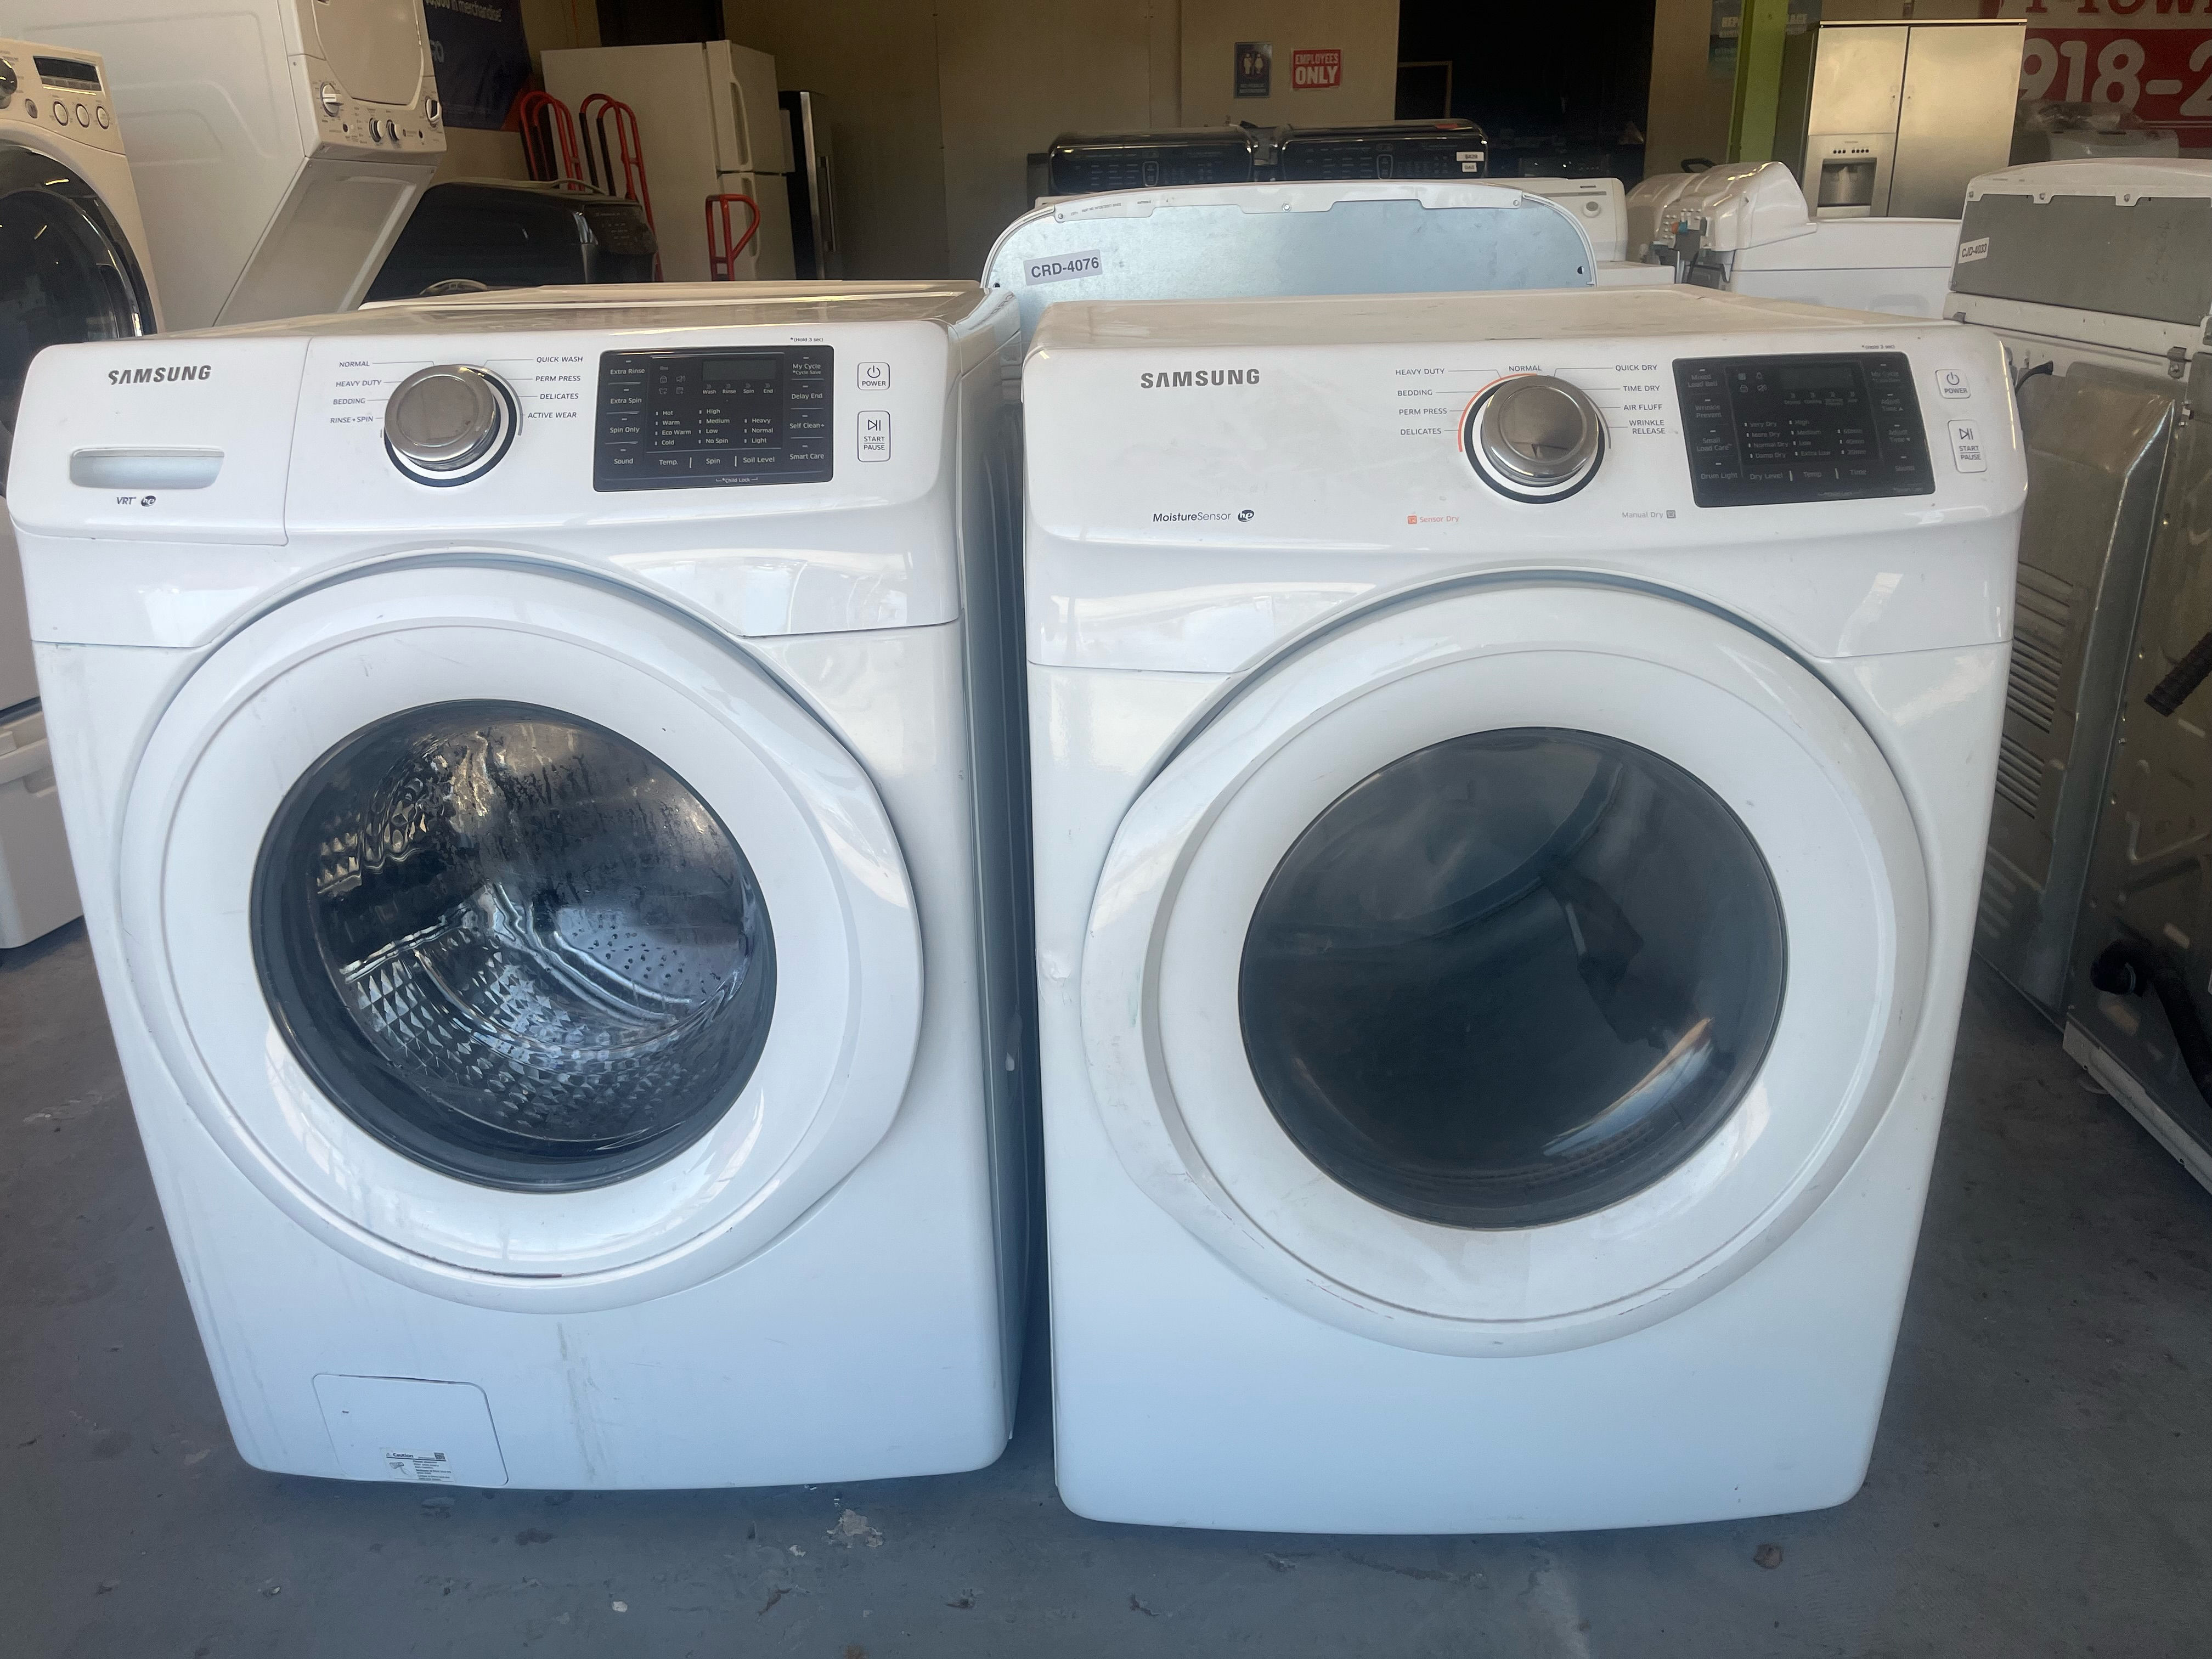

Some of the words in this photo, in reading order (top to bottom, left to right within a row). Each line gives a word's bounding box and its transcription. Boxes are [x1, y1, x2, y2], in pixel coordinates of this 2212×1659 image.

[1295, 53, 1339, 65] EMPLOYEES
[1295, 65, 1339, 85] ONLY
[1962, 243, 1987, 258] CJD-4033
[1030, 256, 1099, 279] CRD-4076
[108, 365, 212, 385] SAMSUNG
[1141, 368, 1260, 389] SAMSUNG
[1153, 511, 1231, 522] MoistureSensor
[1446, 515, 1459, 524] Dry
[1650, 511, 1663, 520] Dry
